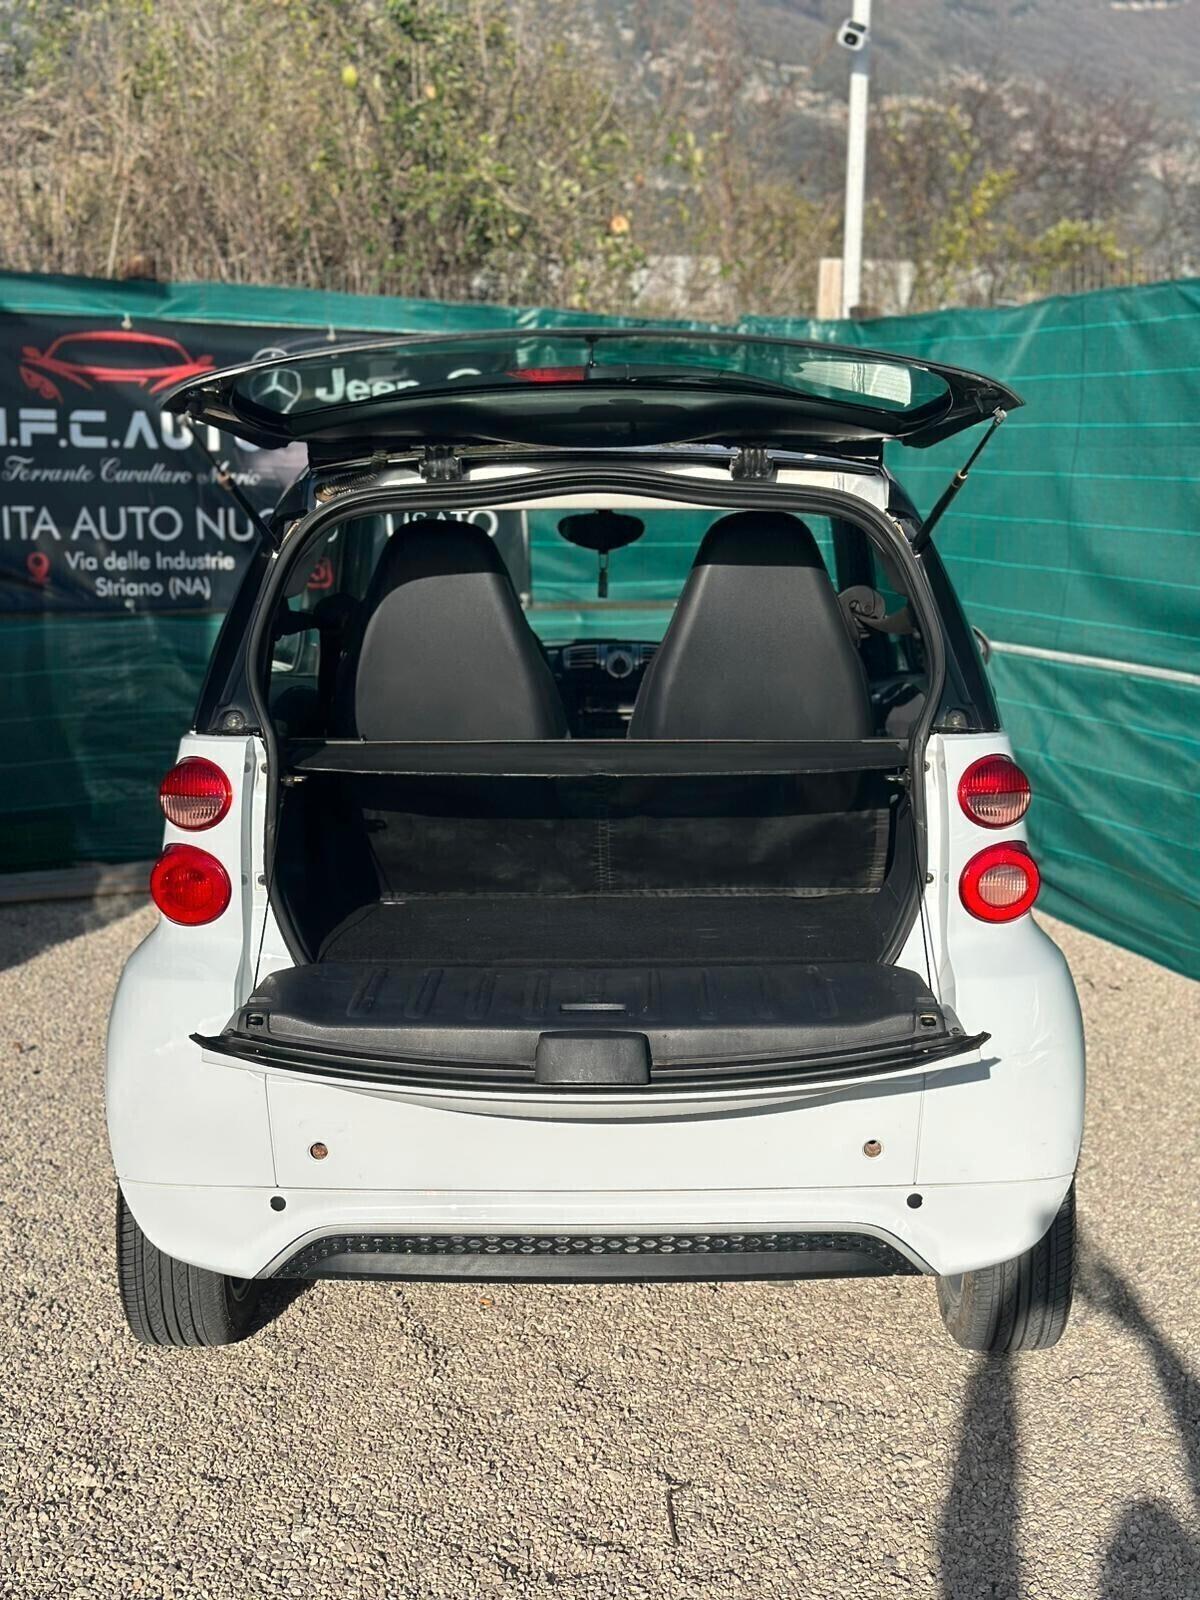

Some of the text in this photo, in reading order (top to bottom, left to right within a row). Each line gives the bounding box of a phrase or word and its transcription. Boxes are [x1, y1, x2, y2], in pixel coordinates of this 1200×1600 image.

[315, 367, 420, 403] Jee
[1, 455, 96, 483] Ferrante
[100, 457, 193, 484] Cavallaro
[71, 506, 183, 542] AUTO
[64, 551, 235, 571] Via delle Industrie
[95, 577, 211, 599] Striano (NA)
